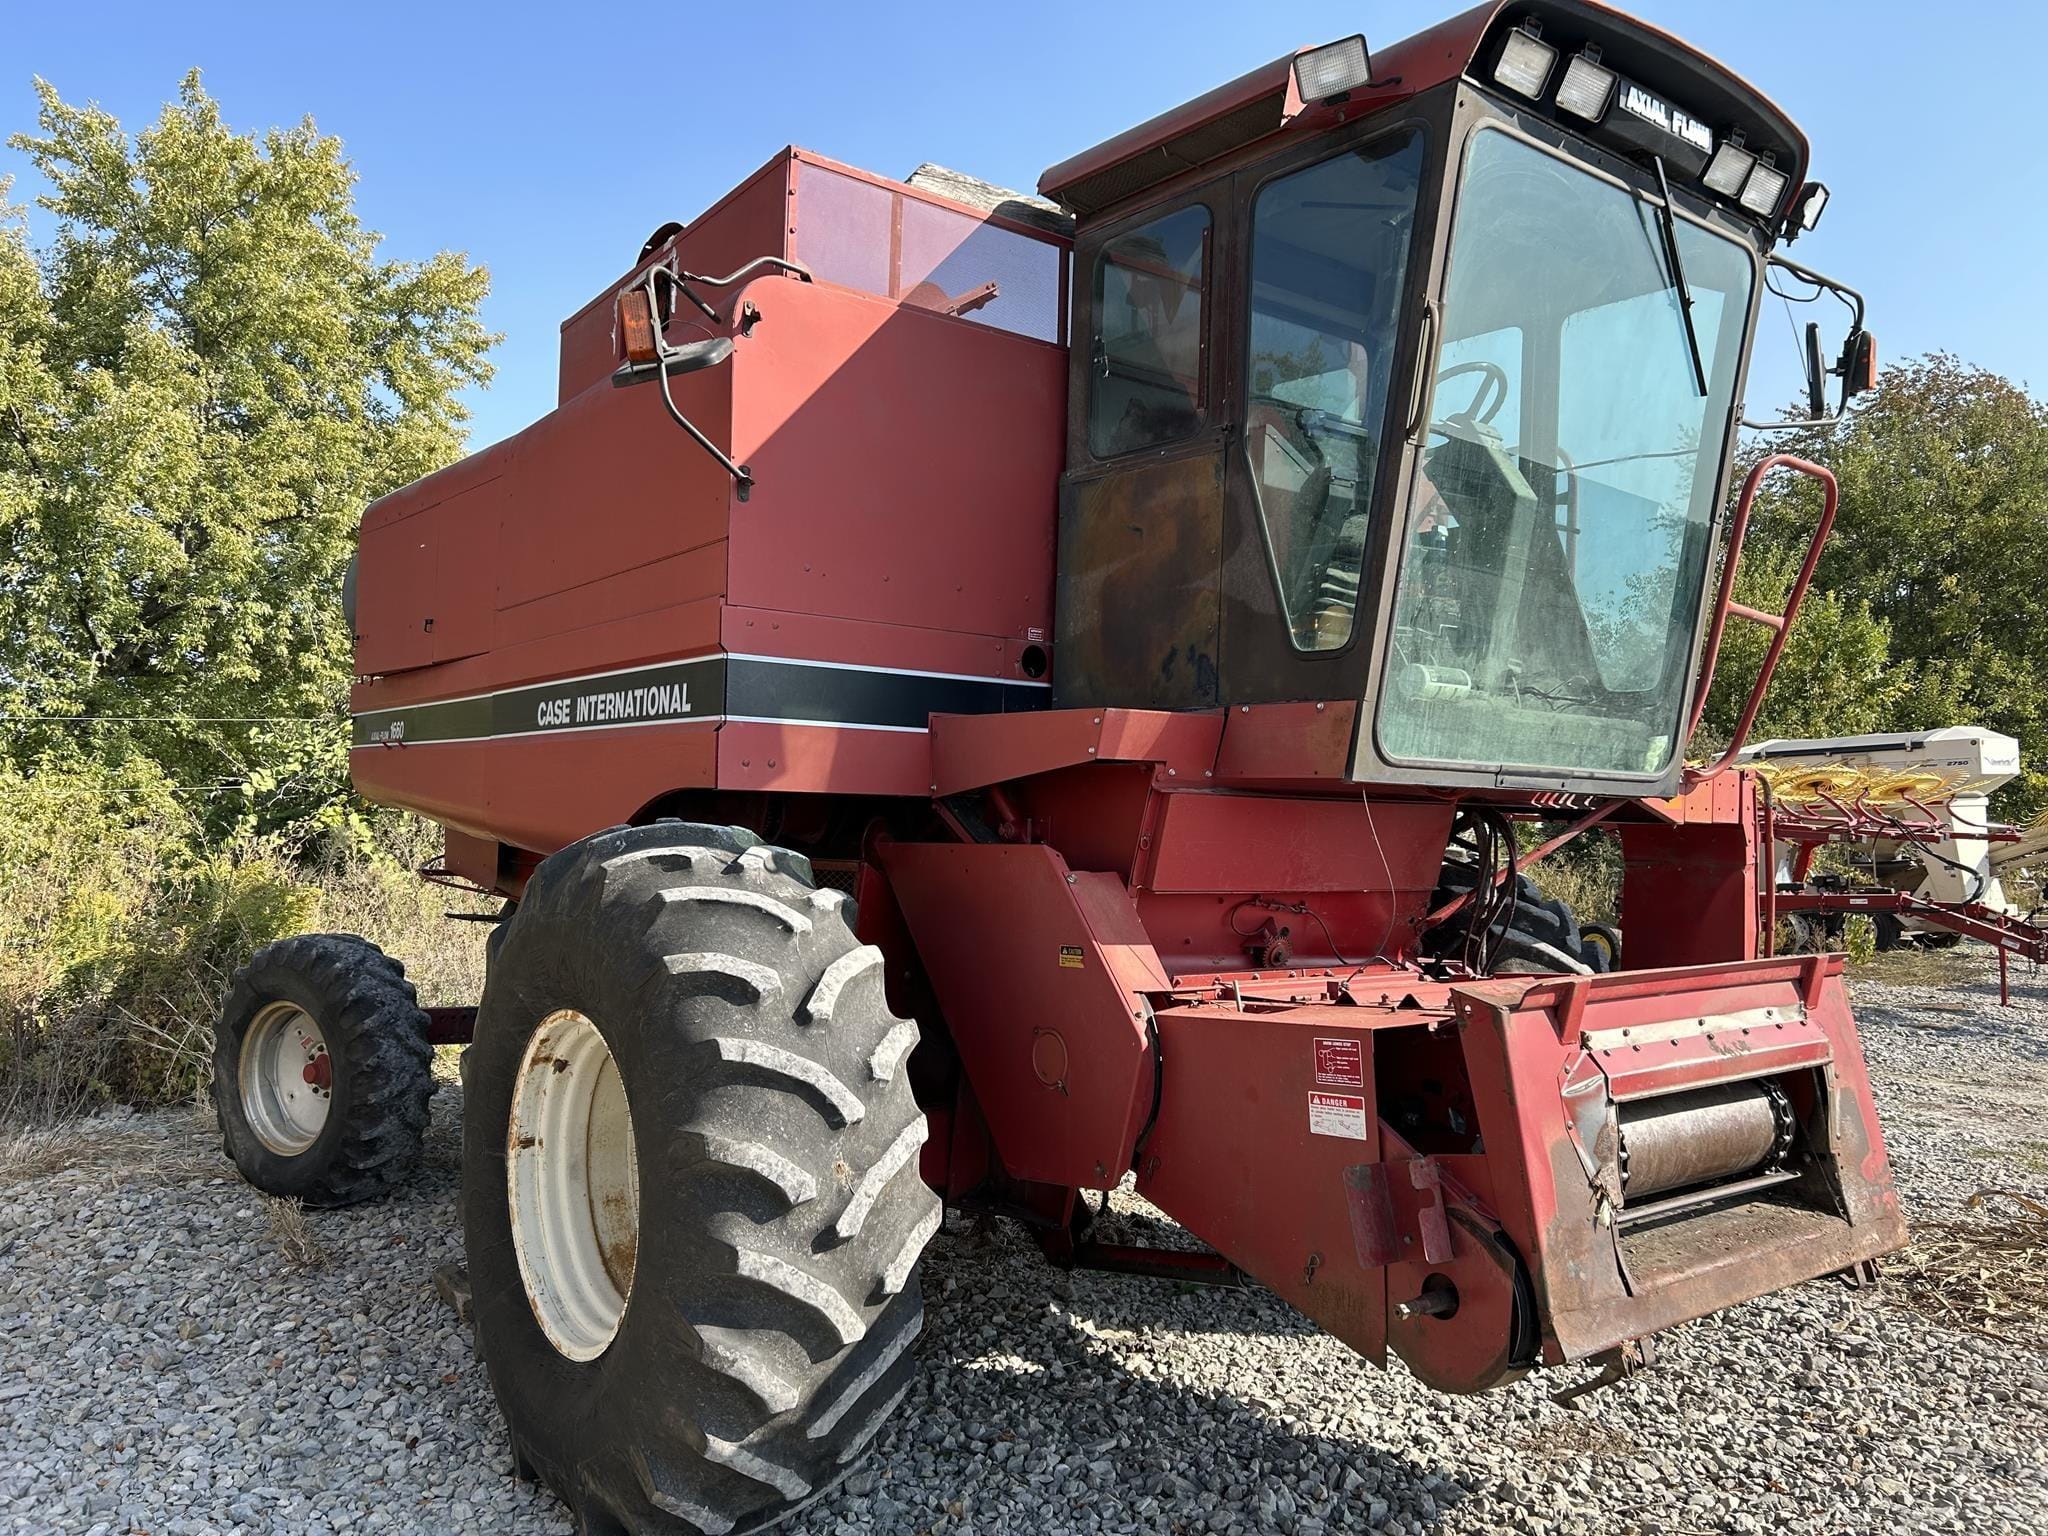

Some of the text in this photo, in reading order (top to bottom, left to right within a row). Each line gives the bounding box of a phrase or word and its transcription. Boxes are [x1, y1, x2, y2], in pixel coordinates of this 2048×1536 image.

[1626, 85, 1710, 149] AXIAL FLOW
[537, 682, 692, 726] CASE INTERNATIONAL
[390, 720, 405, 739] 1660
[1321, 1097, 1348, 1107] DANGER
